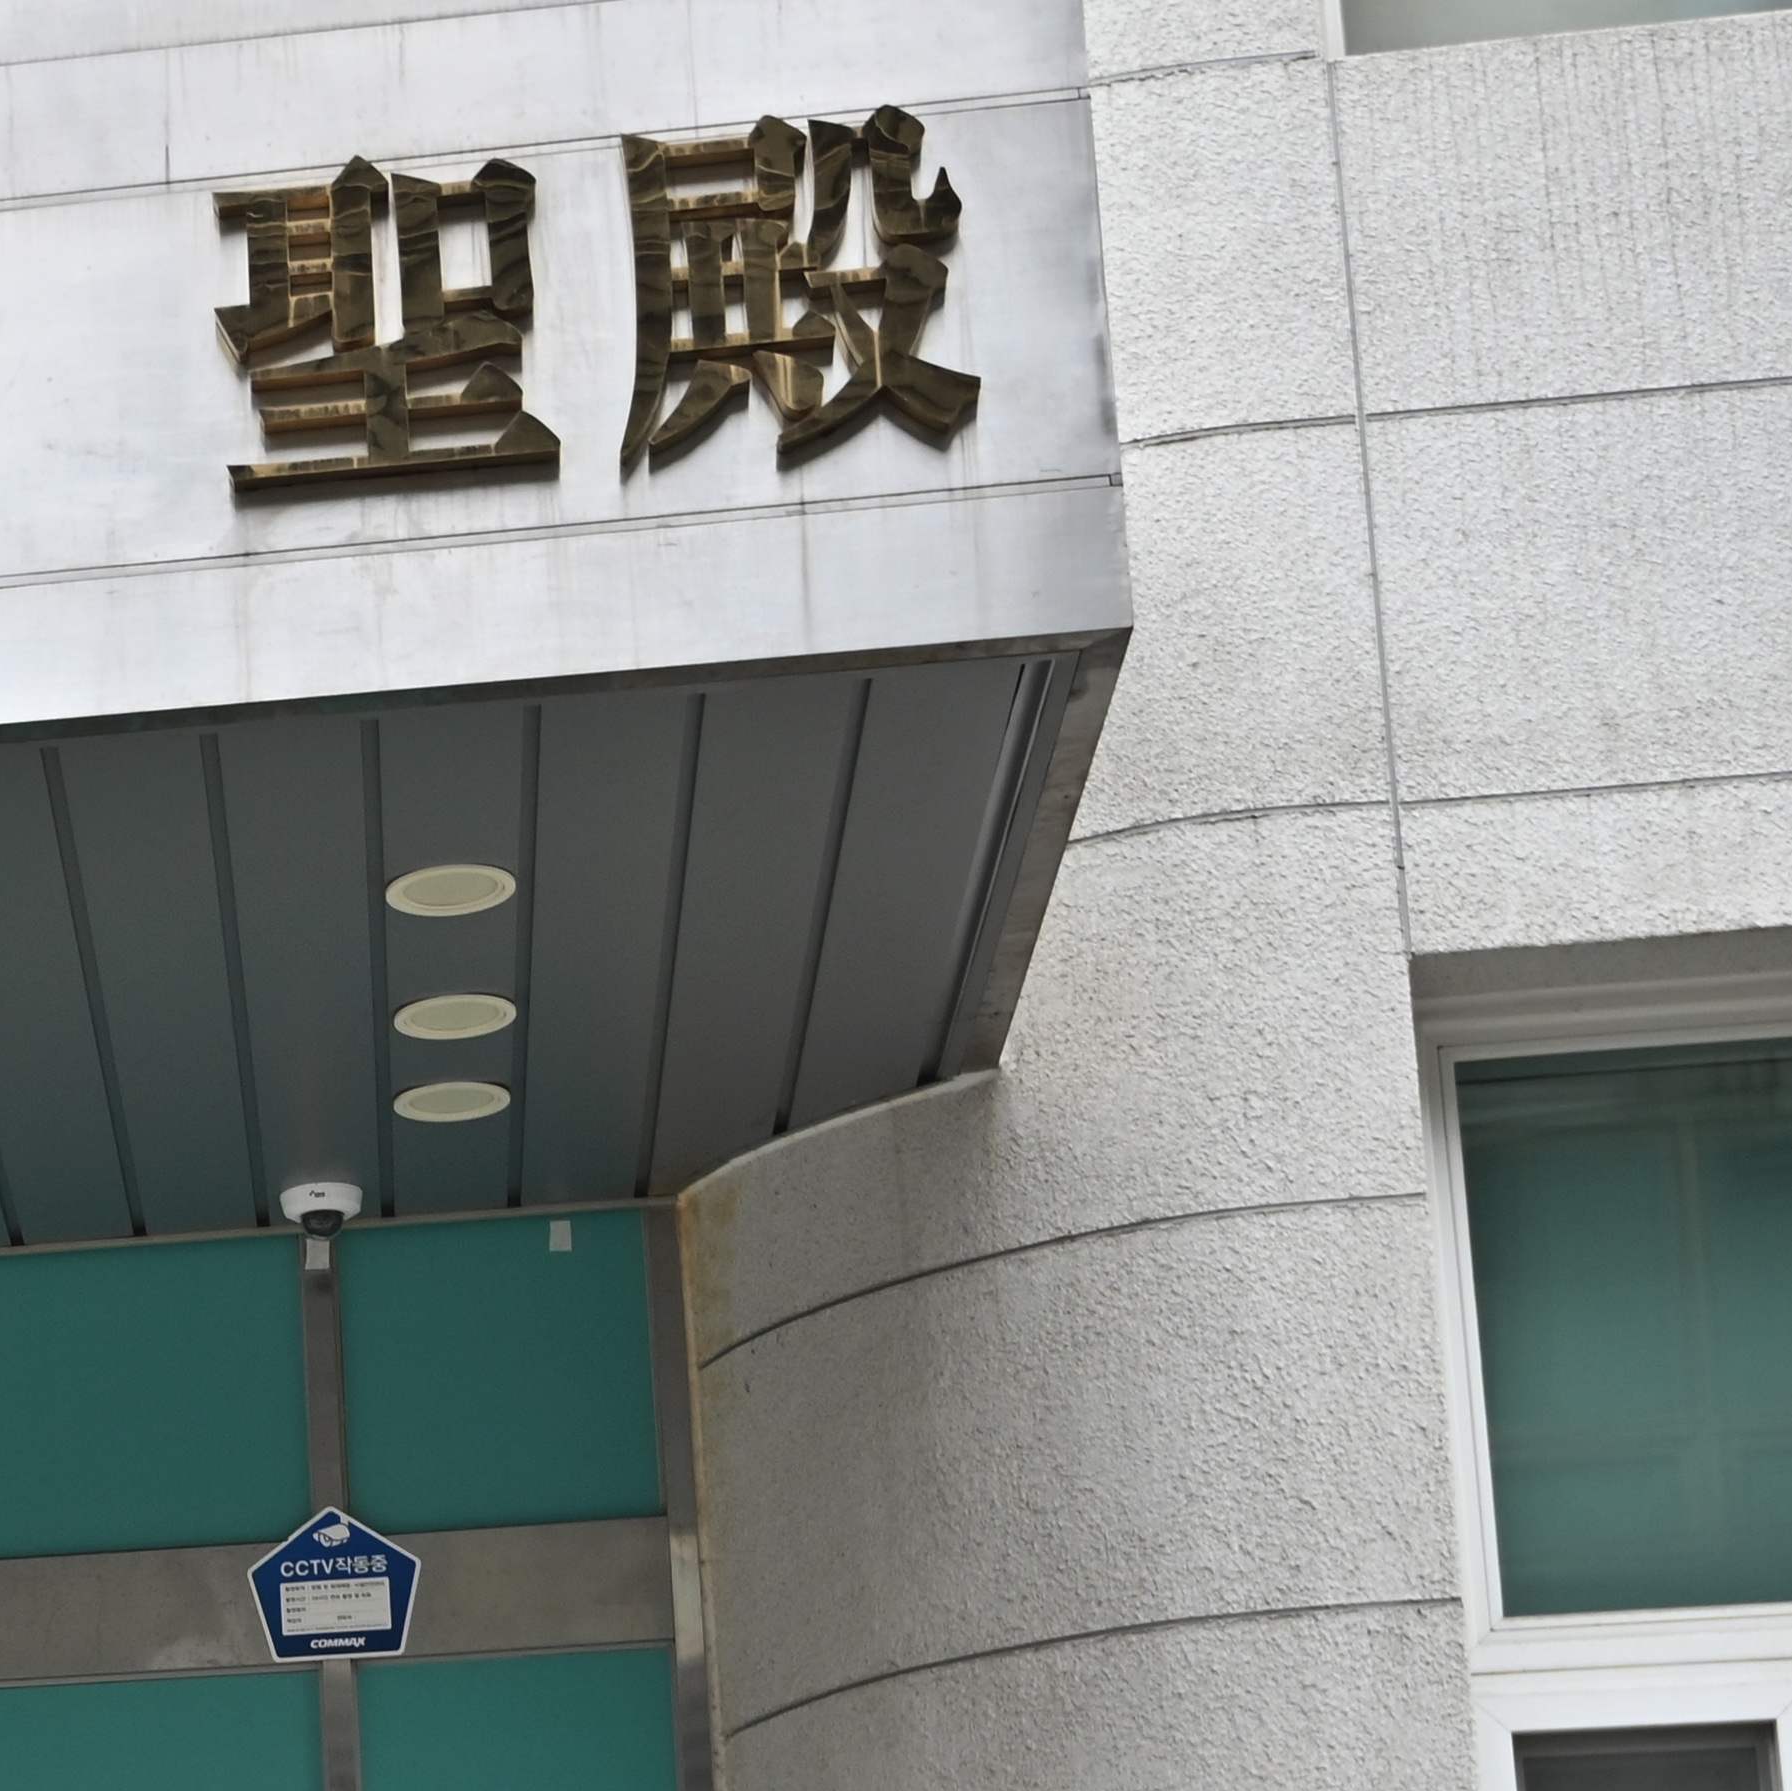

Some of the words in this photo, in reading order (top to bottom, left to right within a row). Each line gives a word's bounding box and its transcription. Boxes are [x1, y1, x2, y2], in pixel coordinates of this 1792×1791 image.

[213, 103, 982, 492] 聖殿
[280, 1553, 389, 1578] CCTV작동중
[310, 1636, 366, 1649] COMMAX
